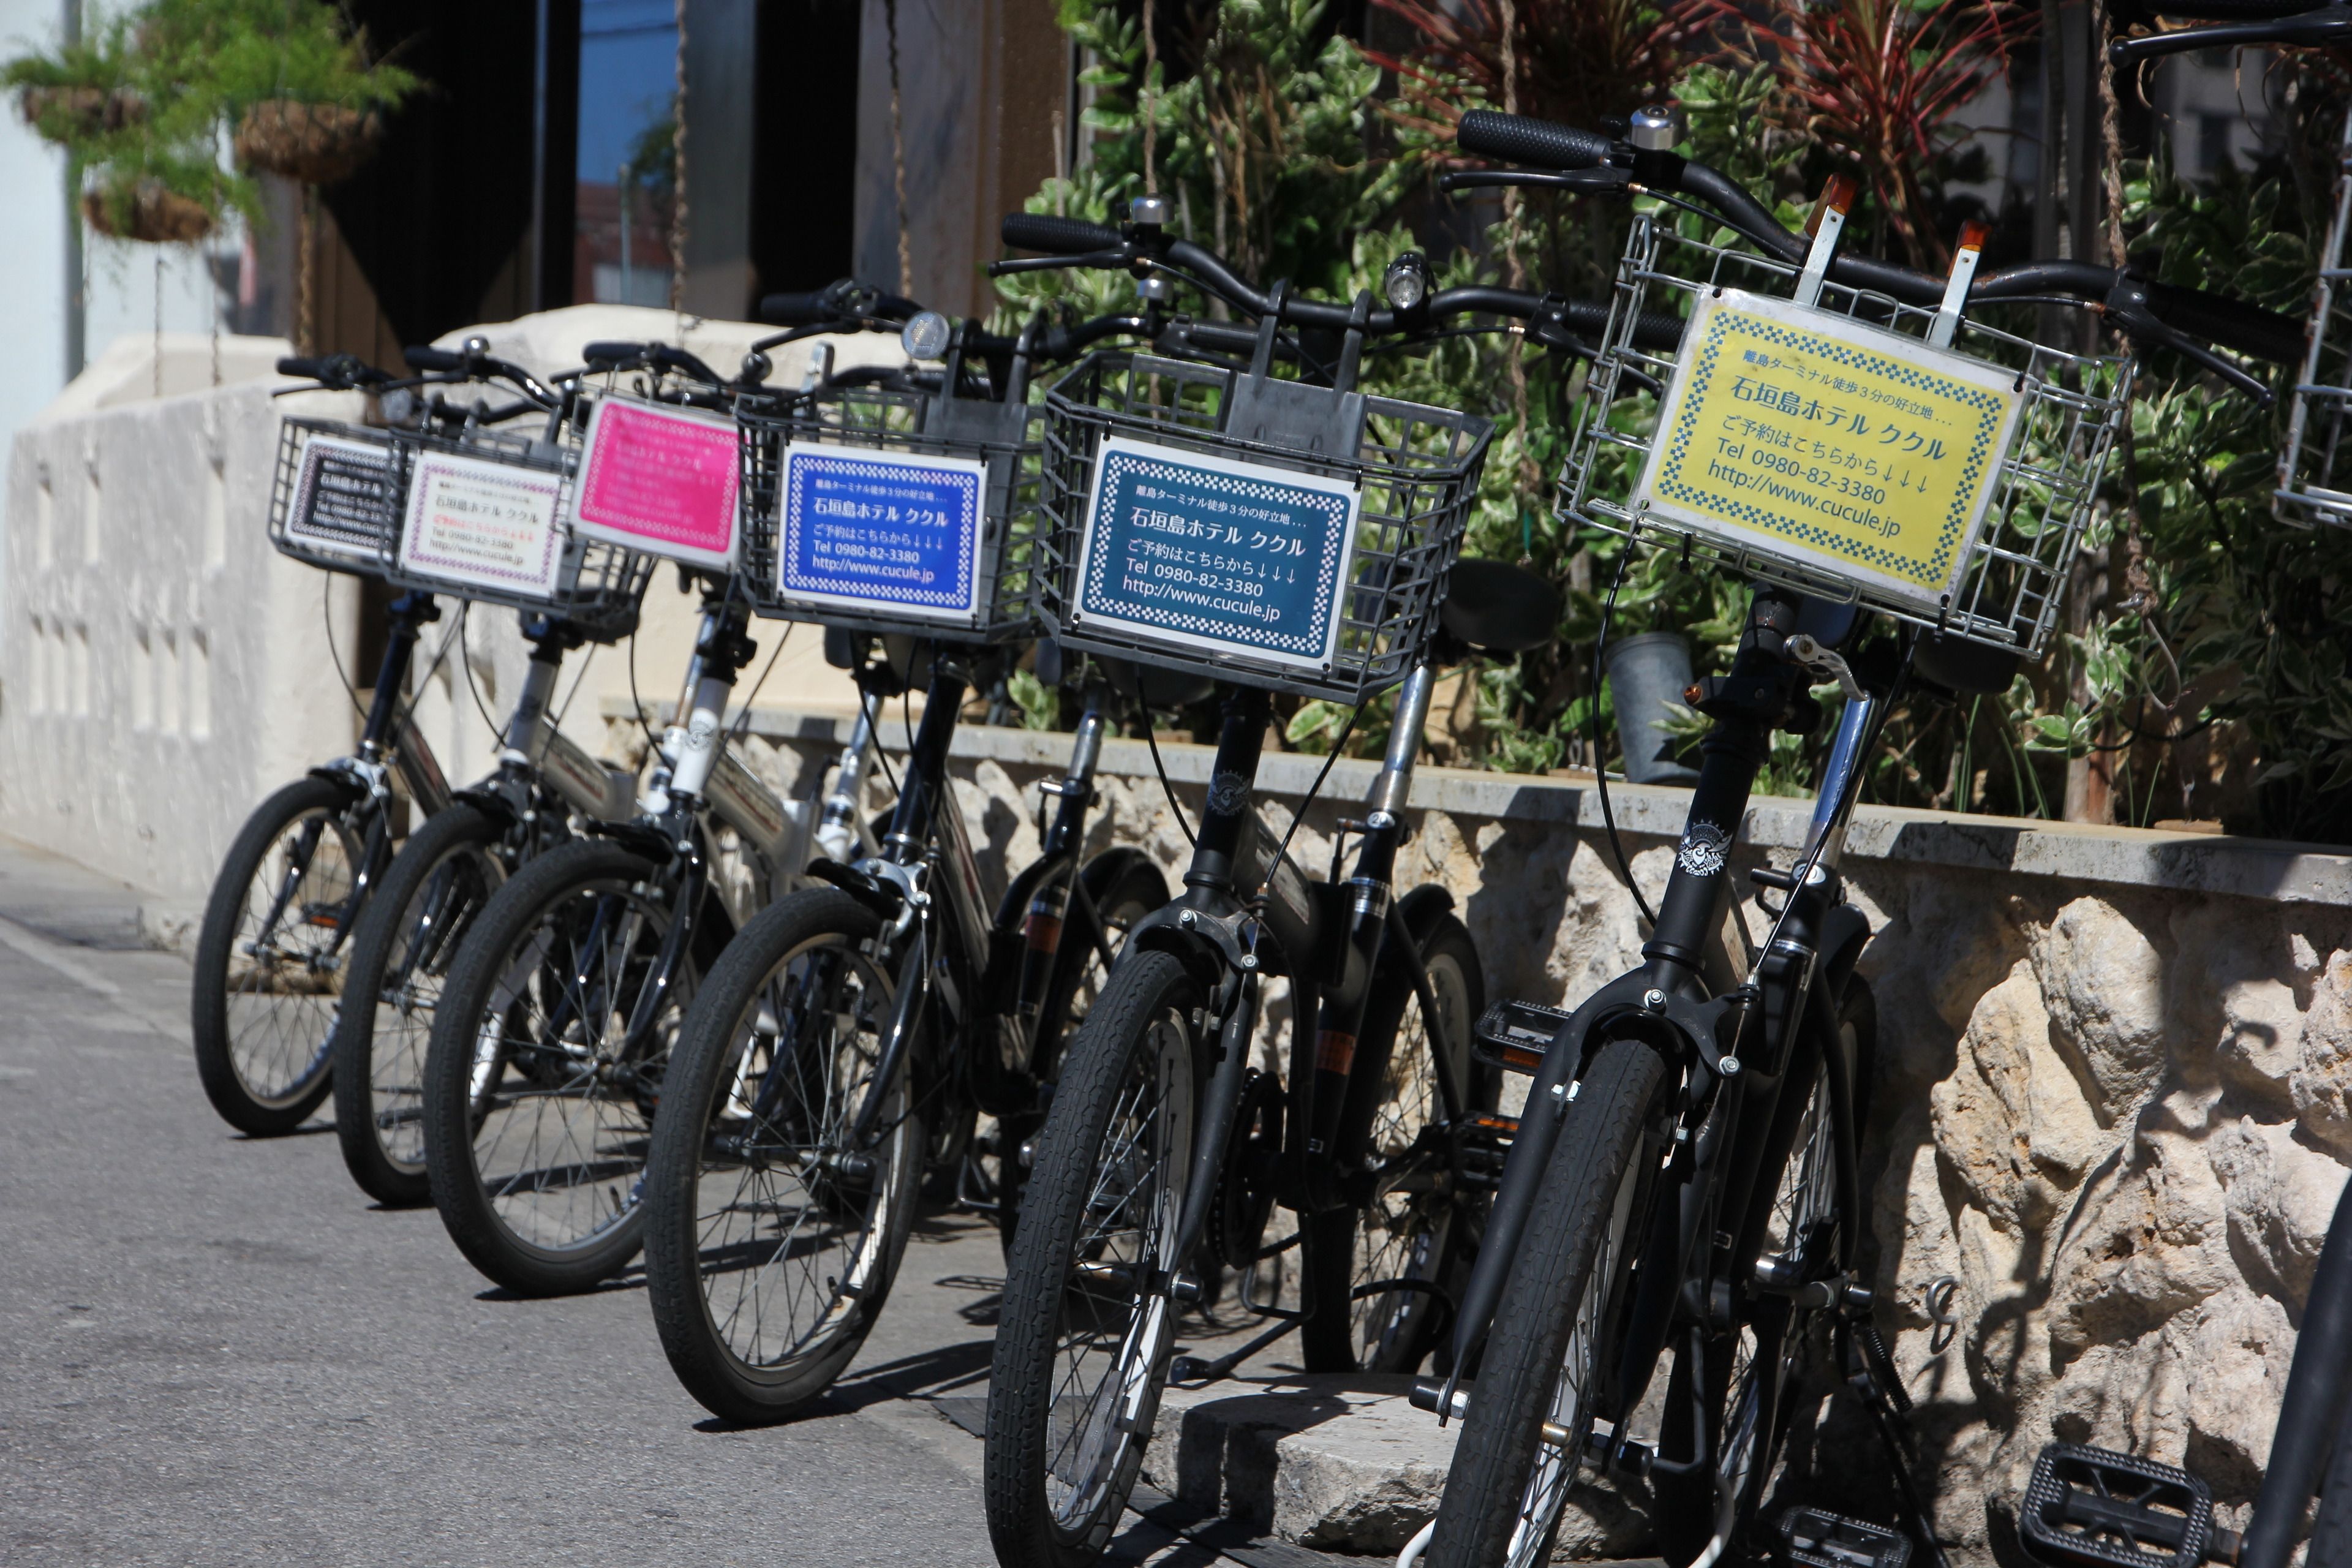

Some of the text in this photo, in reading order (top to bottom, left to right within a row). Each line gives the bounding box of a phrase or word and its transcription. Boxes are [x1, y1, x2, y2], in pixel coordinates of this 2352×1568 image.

[1730, 375, 1947, 461] 石垣島ホテル ククル
[1722, 413, 1878, 477] ご予約はこちらから
[1717, 437, 1886, 505] Tel 0980-82-3380
[331, 503, 393, 522] 0980-82-33
[435, 494, 539, 524] 石垣島ホテル ククル
[813, 497, 949, 528] 石垣島ホテル ククル
[1708, 459, 1901, 538] http://www.cucule.jp
[313, 510, 393, 537] http://www.cuc
[432, 527, 513, 550] Tel 0980-82-3380
[813, 523, 911, 546] ご予約はこちらから
[1130, 506, 1306, 557] 石垣島ホテル ククル
[430, 539, 524, 565] http://www.cucule.jp
[813, 540, 919, 564] Tel 0980-82-3380
[1128, 538, 1254, 576] ご予約はこちらから
[812, 554, 935, 584] http://www.cucule.jp
[1126, 557, 1263, 597] Tel 0980-82-3380
[1123, 575, 1281, 622] http://www.cucule.jp
